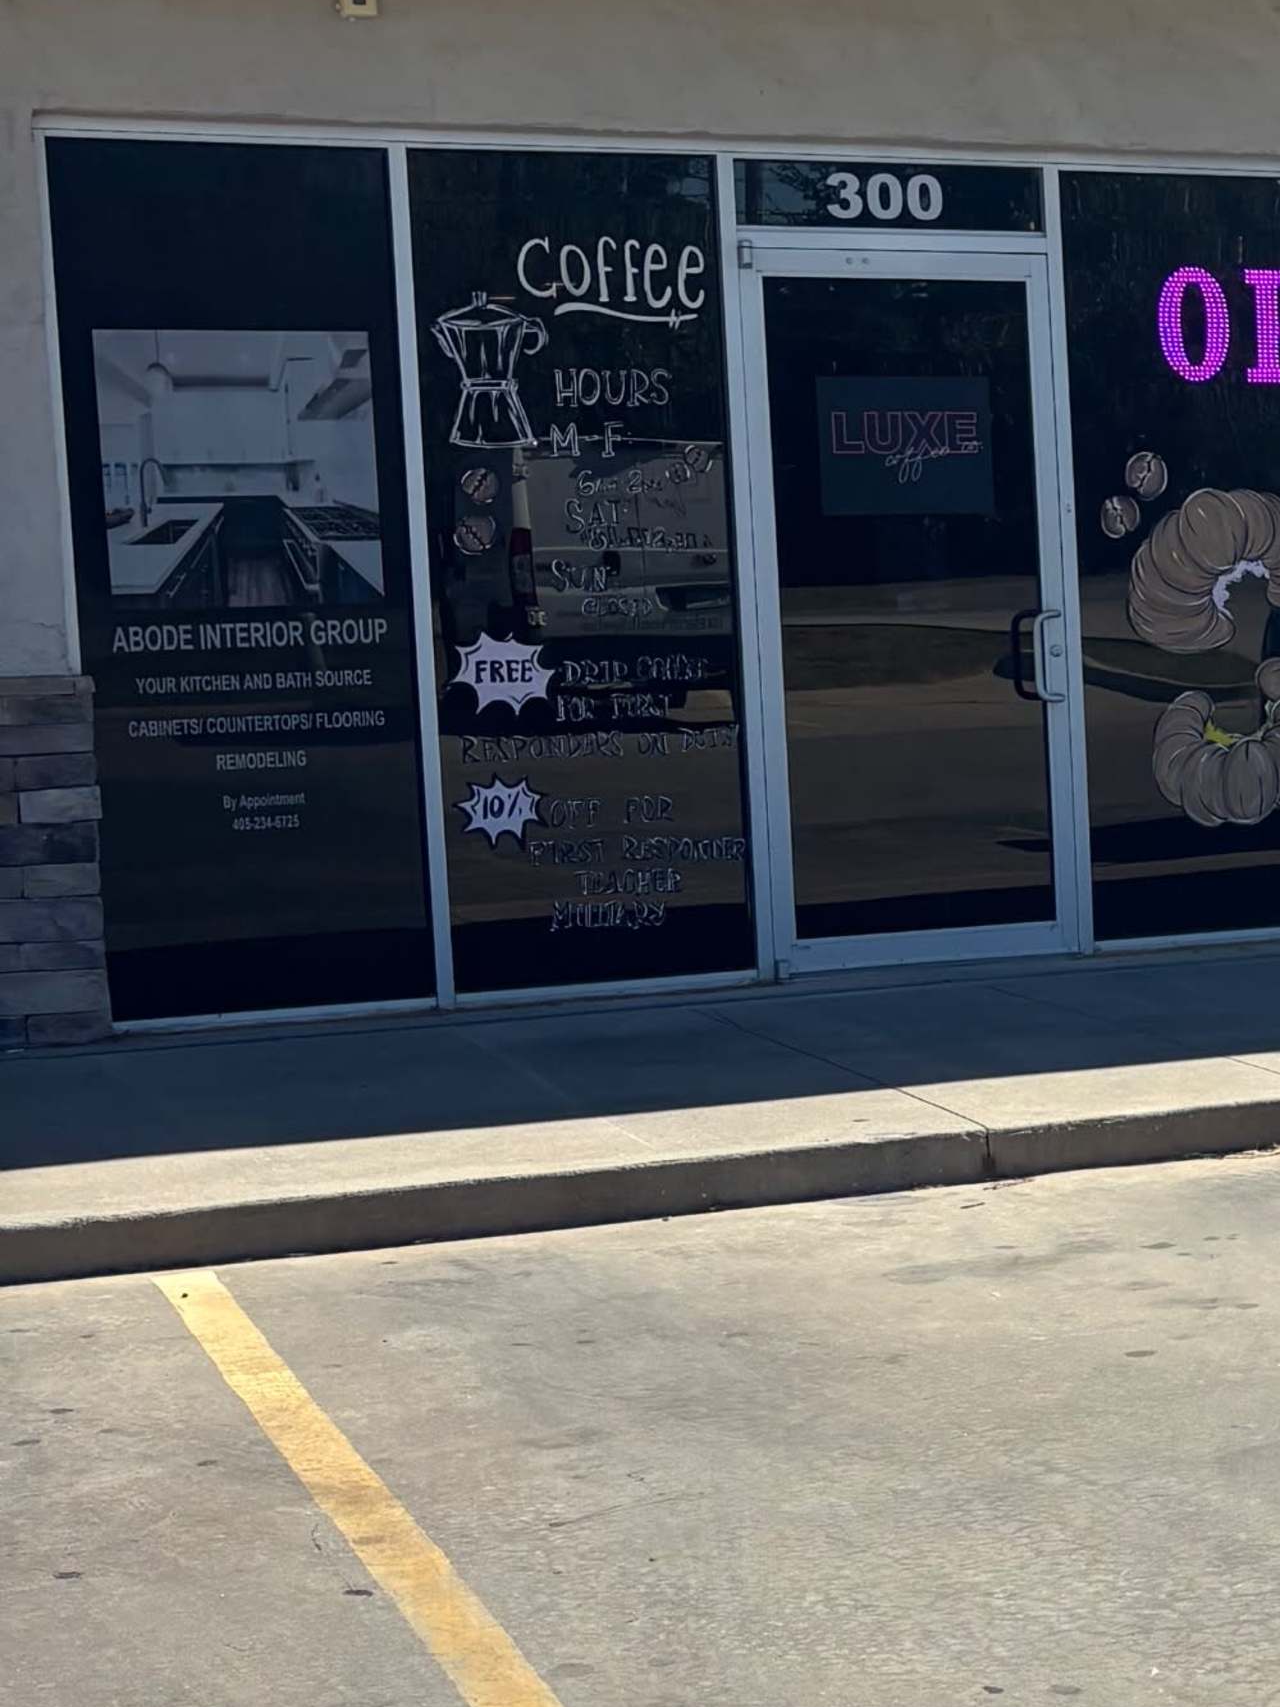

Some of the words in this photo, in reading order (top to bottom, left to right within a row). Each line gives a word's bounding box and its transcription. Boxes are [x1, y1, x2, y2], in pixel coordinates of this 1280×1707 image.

[825, 171, 943, 221] 300
[516, 236, 705, 310] Coffee
[553, 367, 673, 408] HOURS
[832, 411, 978, 454] LUXE
[112, 624, 195, 654] ABODE
[200, 620, 305, 651] INTERIOR
[310, 617, 388, 646] GROUP
[135, 676, 178, 695] YOUR
[180, 674, 241, 694] KITCHEN
[243, 672, 273, 692] AND
[275, 670, 312, 690] BATH
[315, 668, 373, 687] SOURCE
[473, 659, 534, 684] FREE
[128, 717, 204, 738] CABINETS/
[206, 713, 313, 734] COUNTERTOPS/
[315, 710, 386, 729] FLOORING
[216, 750, 307, 771] REMODELING
[223, 794, 238, 812] By
[239, 792, 306, 810] Appointment
[482, 793, 523, 820] 10%
